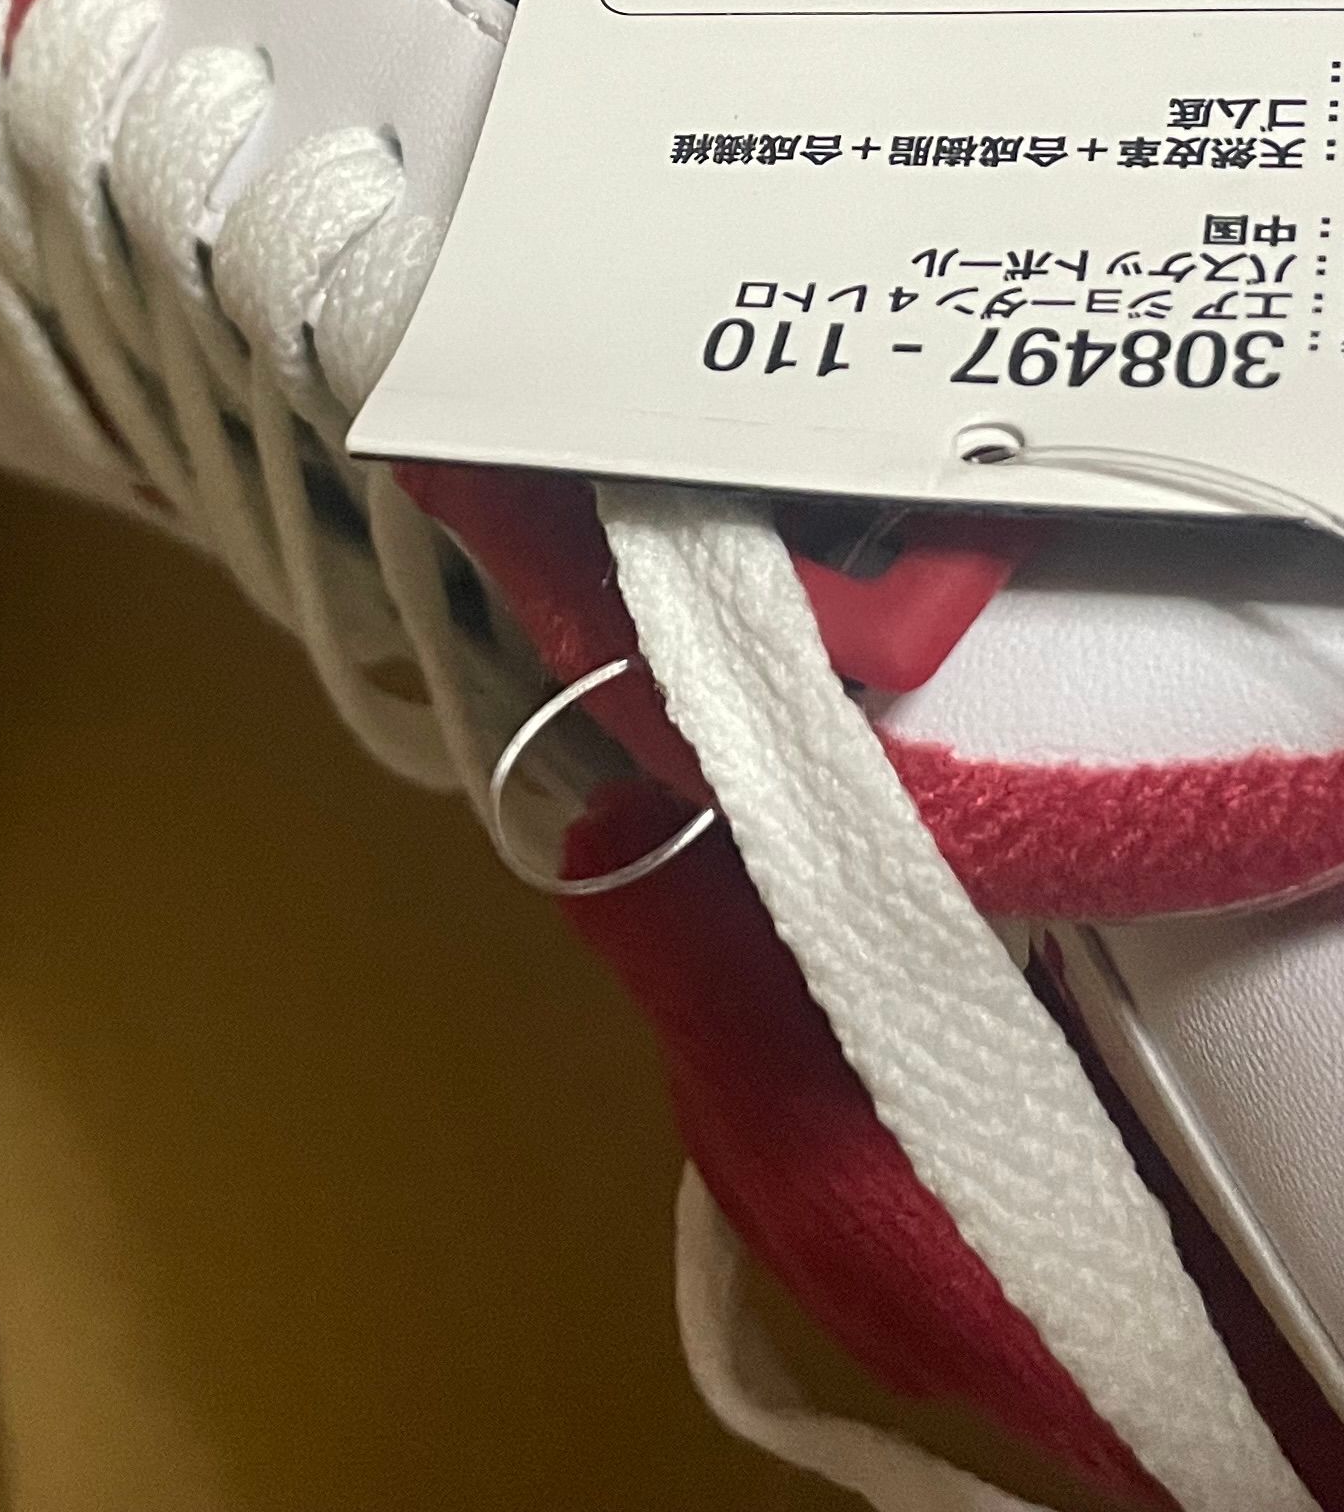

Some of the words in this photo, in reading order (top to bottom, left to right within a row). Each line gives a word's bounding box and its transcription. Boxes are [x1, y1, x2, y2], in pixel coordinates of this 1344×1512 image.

[1166, 97, 1308, 133] ゴム底
[1202, 213, 1298, 248] 中国
[911, 247, 1298, 286] バスケットボール
[702, 317, 850, 378] 110
[949, 326, 1285, 390] 308497
